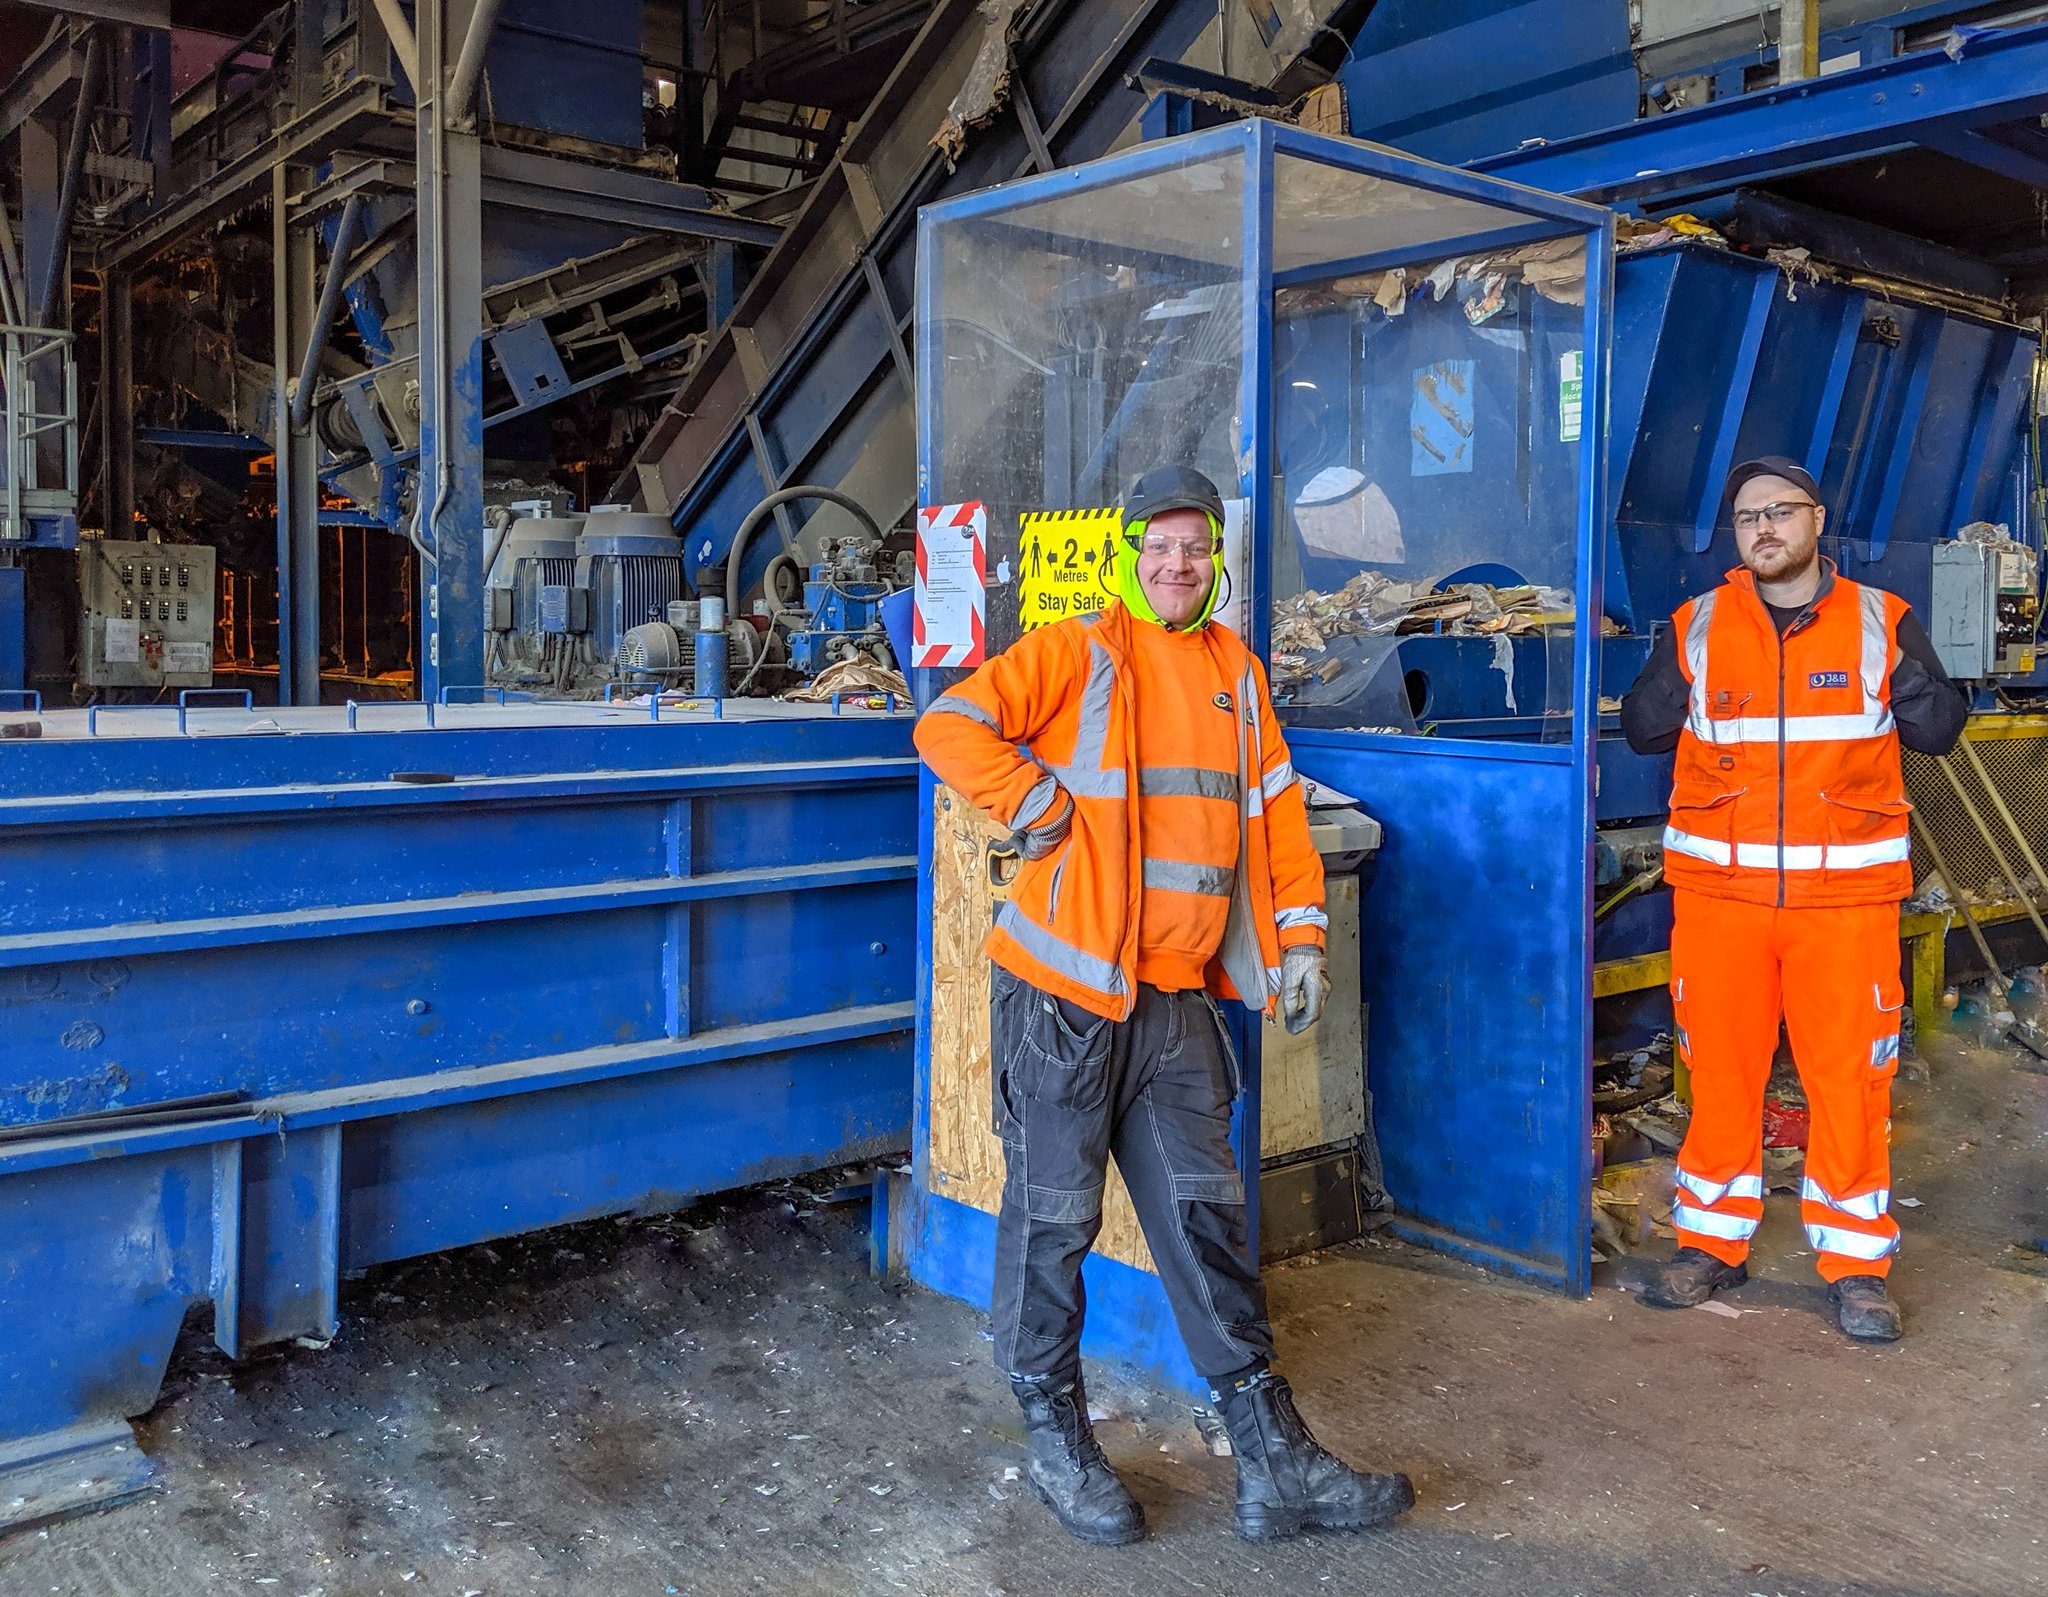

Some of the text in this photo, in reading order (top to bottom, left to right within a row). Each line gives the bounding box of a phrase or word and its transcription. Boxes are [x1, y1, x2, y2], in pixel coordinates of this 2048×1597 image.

[1064, 538, 1078, 568] 2
[1053, 569, 1088, 582] Metres
[1038, 592, 1105, 615] Stay Safe
[1827, 674, 1847, 683] J&B
